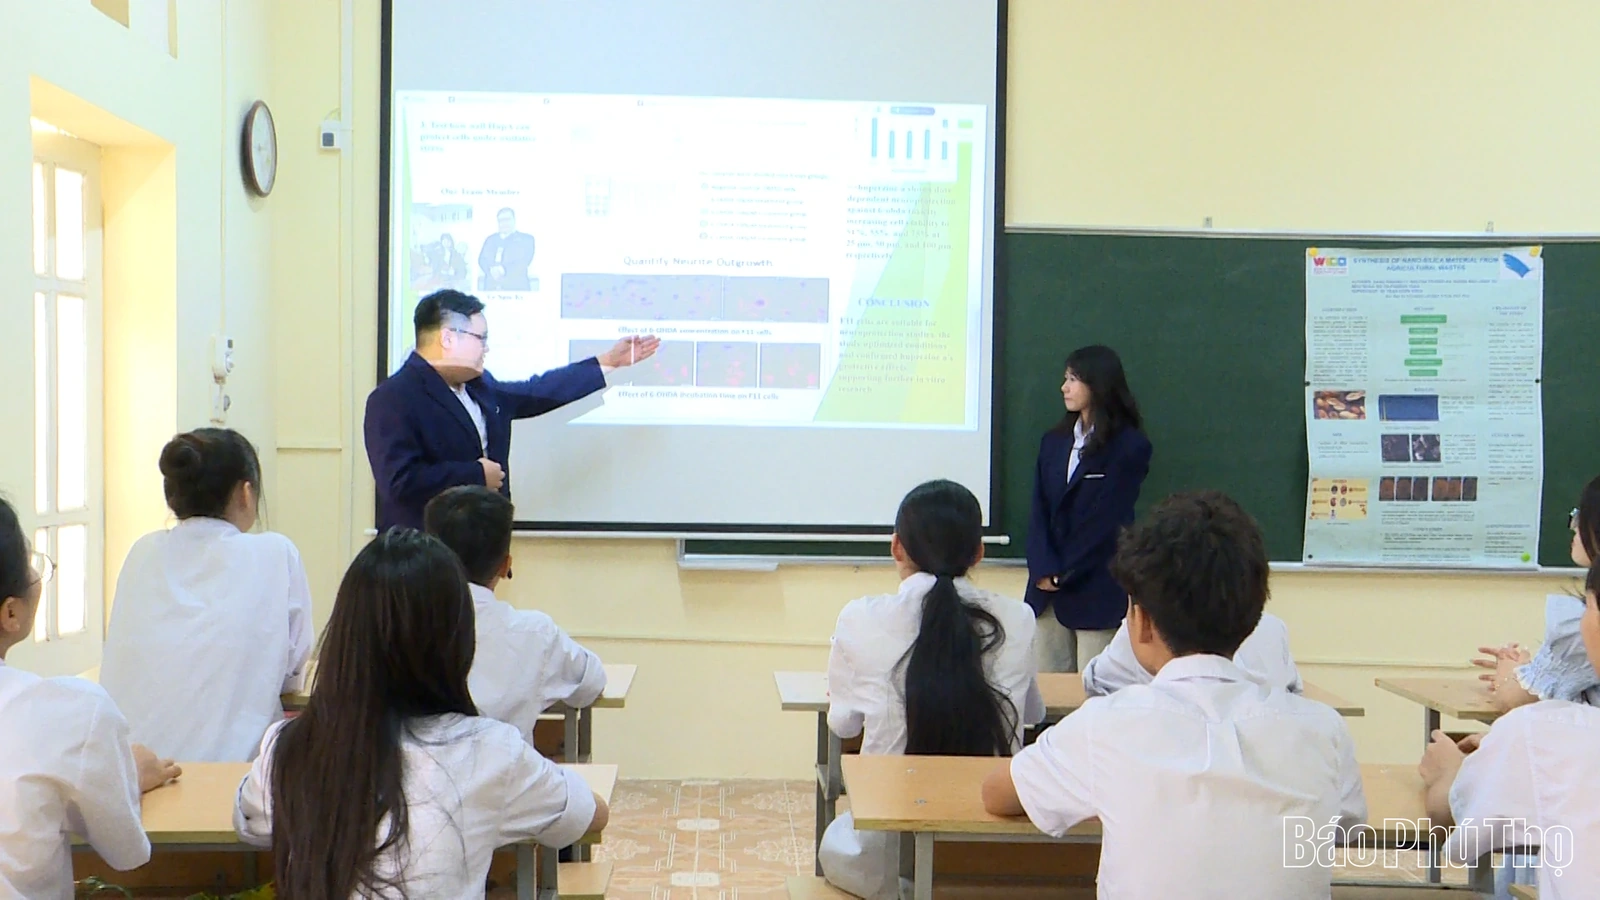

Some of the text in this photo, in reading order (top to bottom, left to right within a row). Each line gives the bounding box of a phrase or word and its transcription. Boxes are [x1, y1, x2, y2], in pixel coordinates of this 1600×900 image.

[623, 256, 773, 268] Quantify Neurite Outgrowth
[1386, 264, 1436, 272] AGRICULTURAL
[858, 297, 930, 308] CONCLUSION
[618, 390, 639, 398] Effect
[640, 390, 649, 398] of
